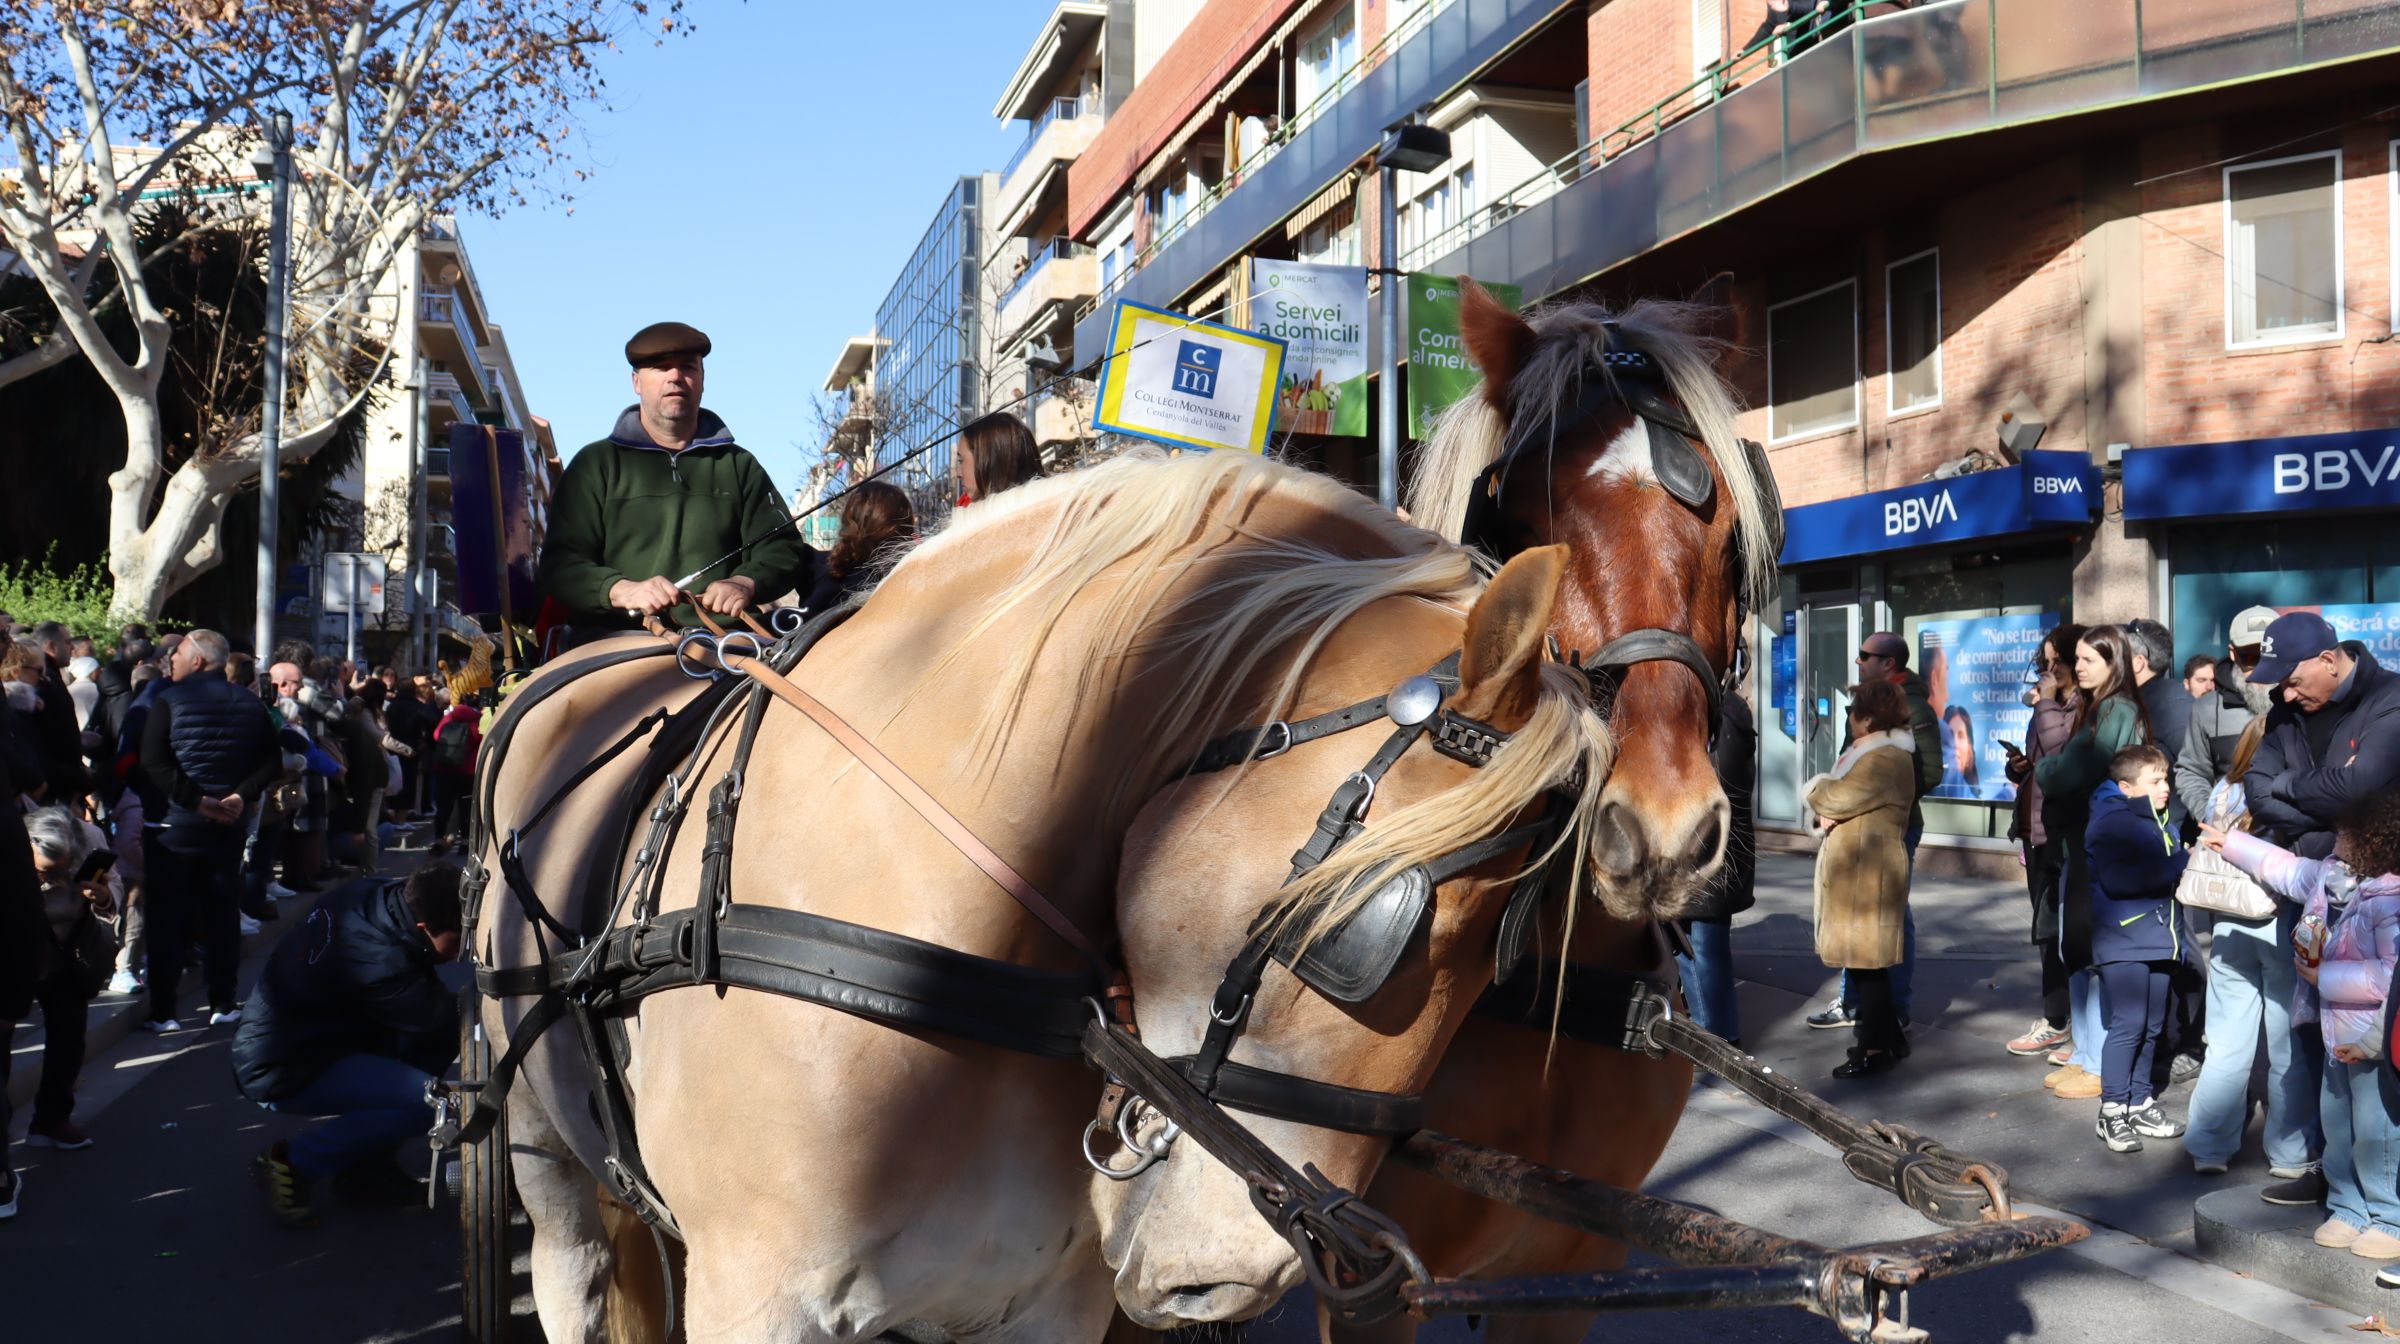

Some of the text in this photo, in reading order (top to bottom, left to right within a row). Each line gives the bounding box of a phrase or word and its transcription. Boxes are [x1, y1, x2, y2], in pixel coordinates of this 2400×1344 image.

[1284, 274, 1318, 283] MERCAT
[1275, 301, 1341, 322] Servei
[1274, 320, 1359, 343] domicili
[1418, 327, 1464, 349] Com
[1412, 347, 1425, 364] al
[1146, 406, 1189, 423] Cerdanyola
[1190, 415, 1202, 426] del
[1179, 399, 1241, 423] MONTSERRAT
[2274, 445, 2400, 494] BBV
[2034, 476, 2083, 494] BBVA
[1884, 488, 1958, 536] BBVA
[2006, 630, 2019, 643] se
[1956, 649, 1971, 665] de
[1972, 645, 2027, 667] competir
[1960, 670, 1990, 685] otros
[1972, 689, 1985, 703] se
[1987, 687, 2017, 703] trata
[1984, 744, 1996, 761] lo
